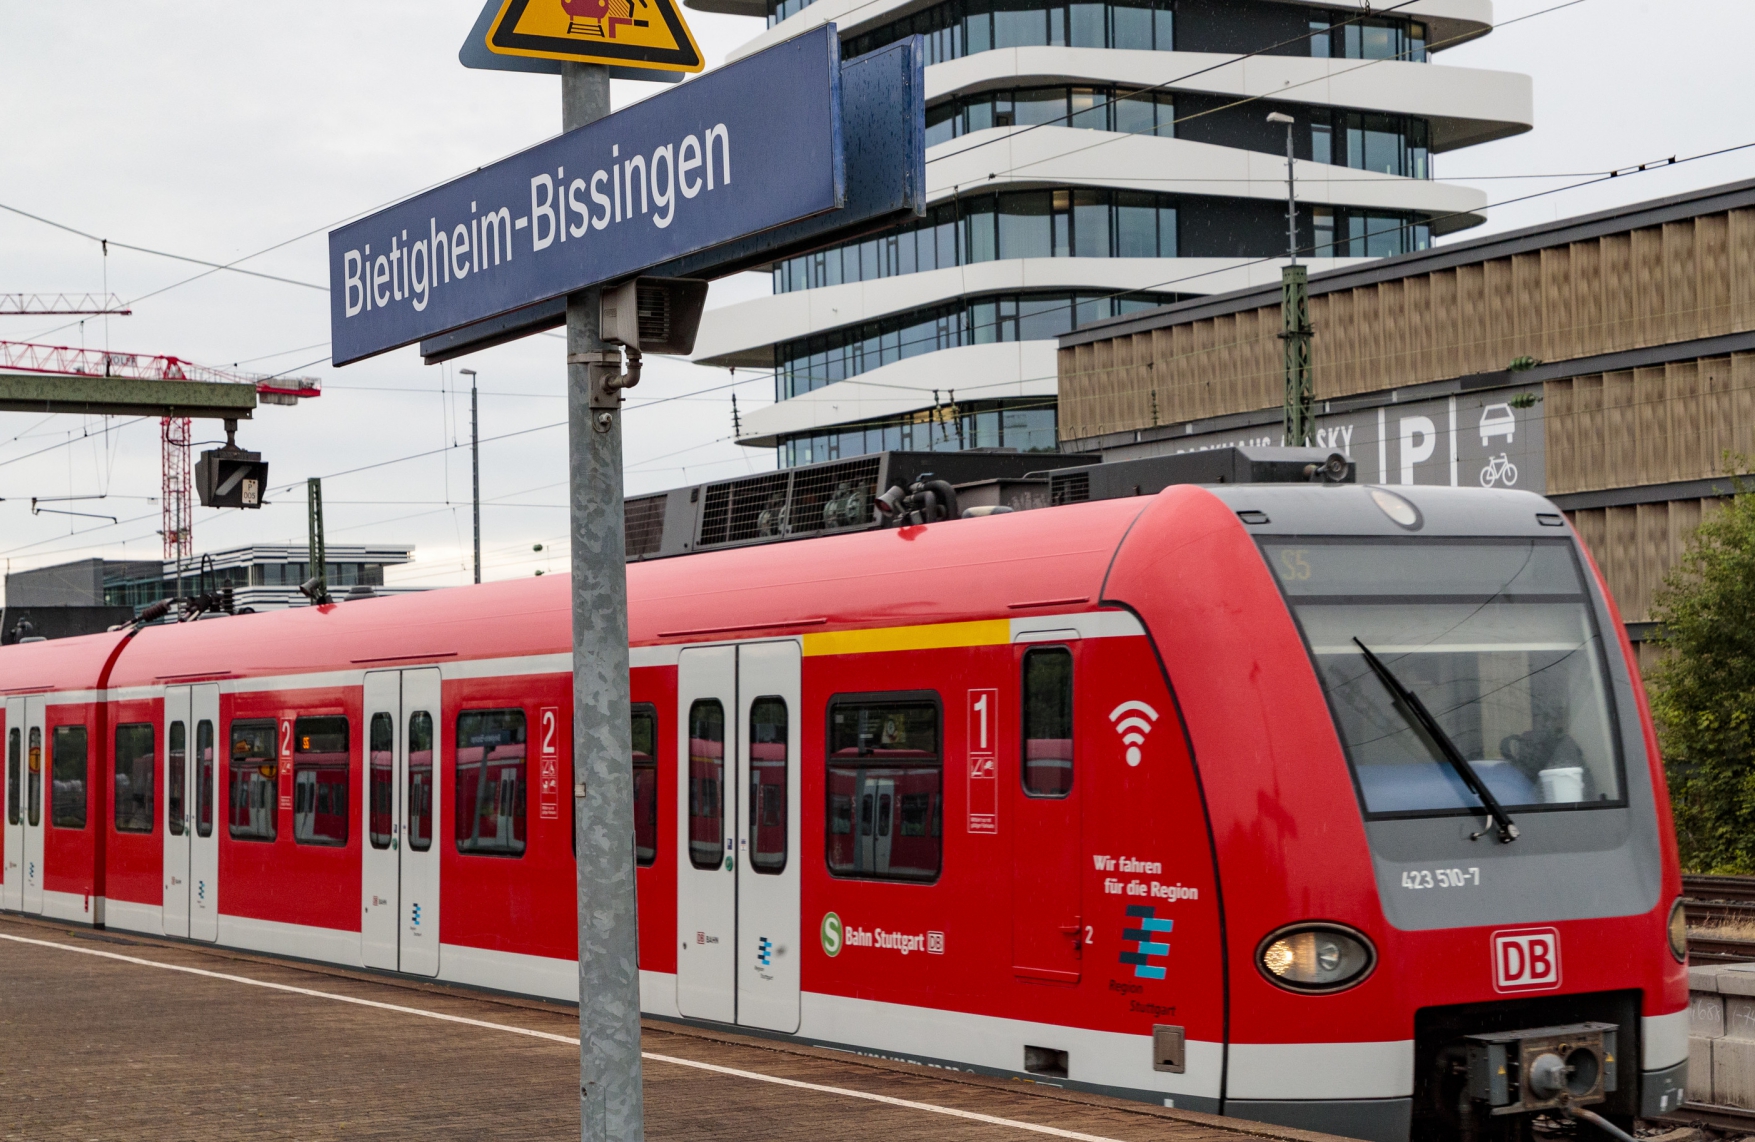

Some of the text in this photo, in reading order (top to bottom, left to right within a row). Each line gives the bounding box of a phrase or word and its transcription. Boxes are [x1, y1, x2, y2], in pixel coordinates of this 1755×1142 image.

[344, 123, 731, 318] Bietigheim-Bissingen
[1400, 416, 1436, 485] P
[1281, 549, 1311, 580] S5
[543, 711, 555, 753] 2
[974, 694, 987, 748] 1
[282, 721, 290, 755] 2
[1093, 855, 1162, 874] Wir fahren
[1402, 867, 1480, 889] 423 510-7
[1105, 878, 1198, 902] für die Region
[824, 916, 840, 952] S
[845, 926, 872, 946] Bahn
[874, 928, 925, 955] Stuttgart
[1085, 925, 1094, 944] 2
[1499, 936, 1554, 984] DB
[1109, 979, 1143, 995] Region
[1129, 1000, 1176, 1017] Stuttgart
